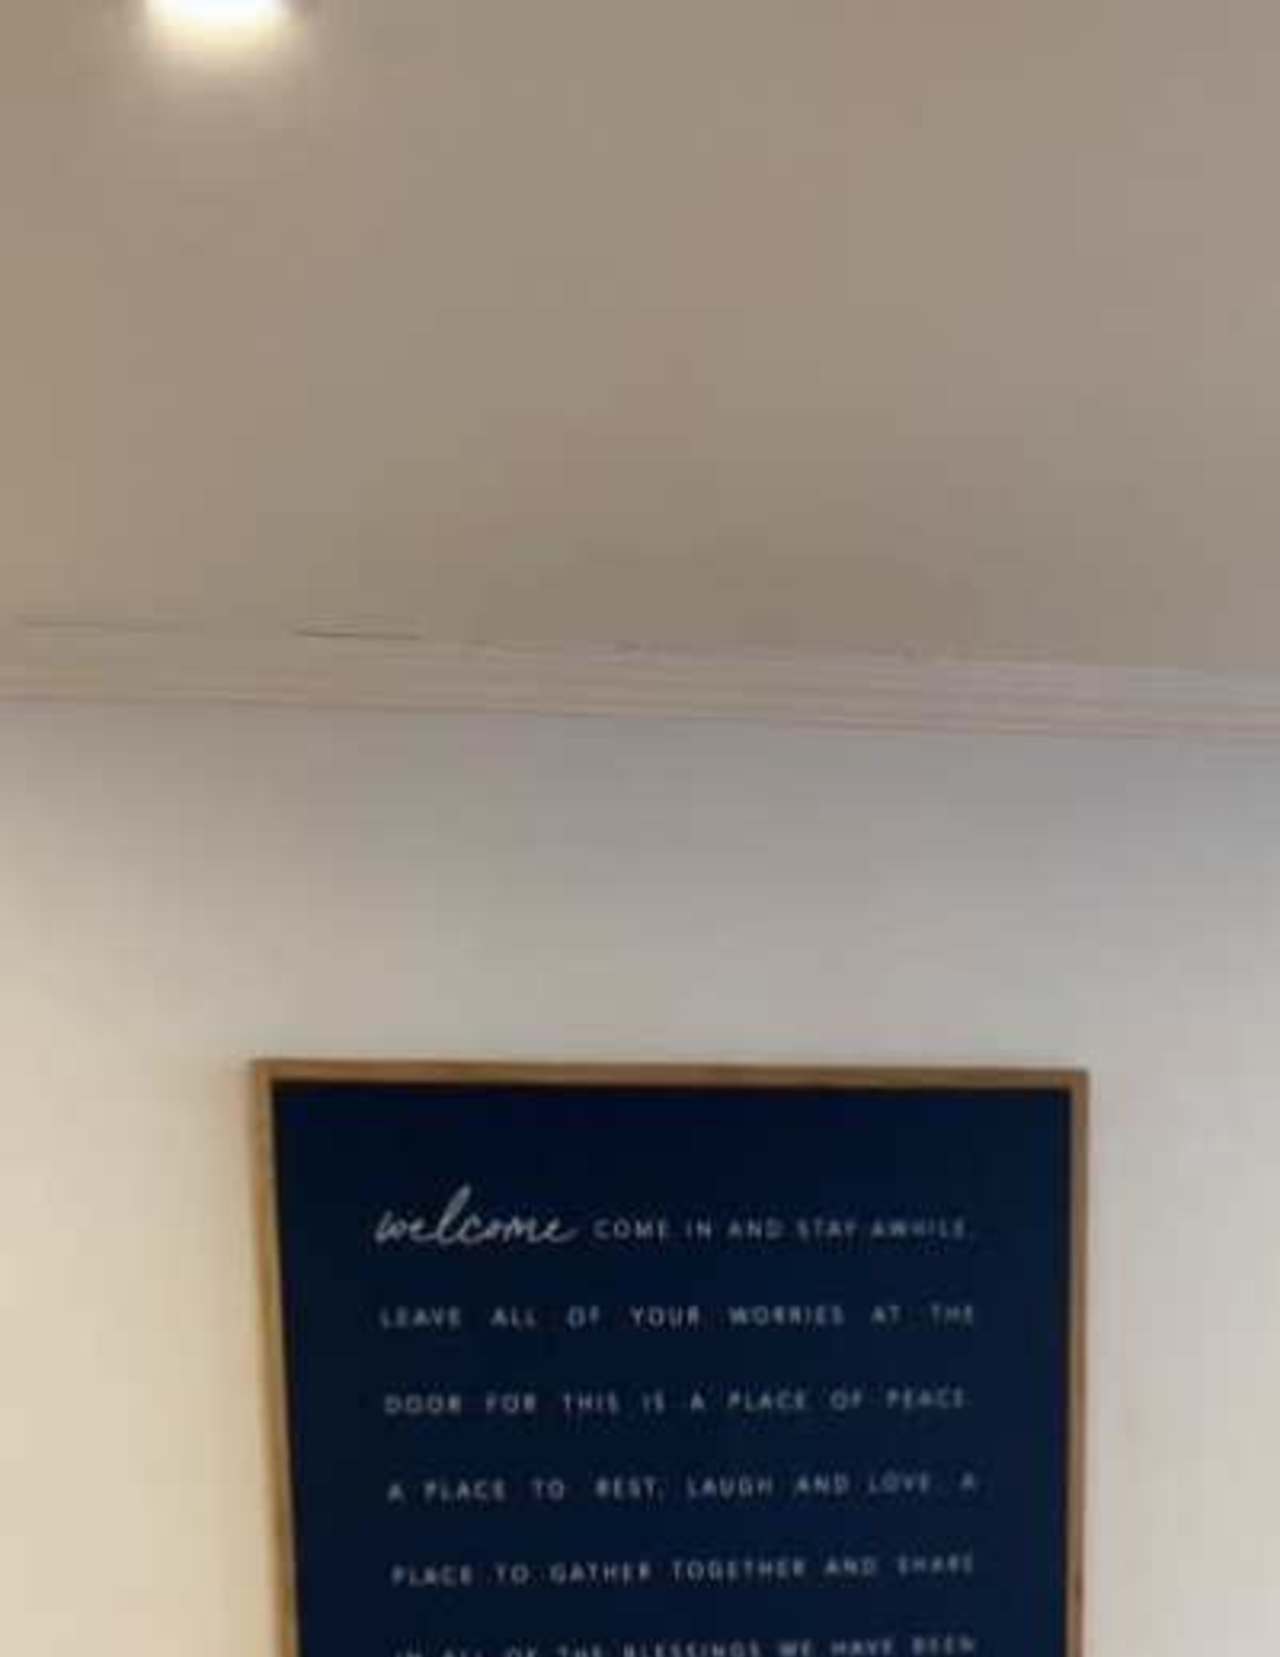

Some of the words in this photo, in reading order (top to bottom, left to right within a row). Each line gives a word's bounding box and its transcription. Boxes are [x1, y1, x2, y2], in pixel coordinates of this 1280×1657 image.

[374, 1183, 577, 1246] welcome
[594, 1217, 669, 1241] COME
[685, 1219, 713, 1239] IN
[727, 1217, 783, 1240] AND
[796, 1217, 857, 1240] STAY
[379, 1306, 461, 1329] LEAVE
[490, 1306, 536, 1327] ALL
[565, 1304, 600, 1329] OF
[630, 1304, 700, 1328] YOUR
[728, 1304, 844, 1326] WORRIES
[870, 1304, 901, 1324] AT
[930, 1302, 974, 1325] THE
[383, 1393, 462, 1416] DOOR
[485, 1392, 537, 1415] FOR
[562, 1391, 620, 1415] THIS
[642, 1389, 665, 1414] IS
[689, 1391, 705, 1411] A
[727, 1389, 806, 1412] PLACE
[829, 1388, 863, 1412] OF
[387, 1482, 404, 1502] A
[423, 1478, 505, 1502] PLACE
[531, 1477, 566, 1501] TO
[686, 1475, 773, 1499] LAUGH
[794, 1472, 849, 1495] AND
[868, 1469, 931, 1494] LOVE
[960, 1472, 976, 1491] A
[391, 1564, 473, 1587] PLACE
[495, 1563, 531, 1585] TO
[549, 1560, 651, 1585] GATHER
[672, 1557, 806, 1581] TOGETHER
[824, 1556, 877, 1577] AND
[896, 1553, 973, 1576] SHARE
[830, 1637, 894, 1657] HAVE
[911, 1634, 976, 1657] BEEN
